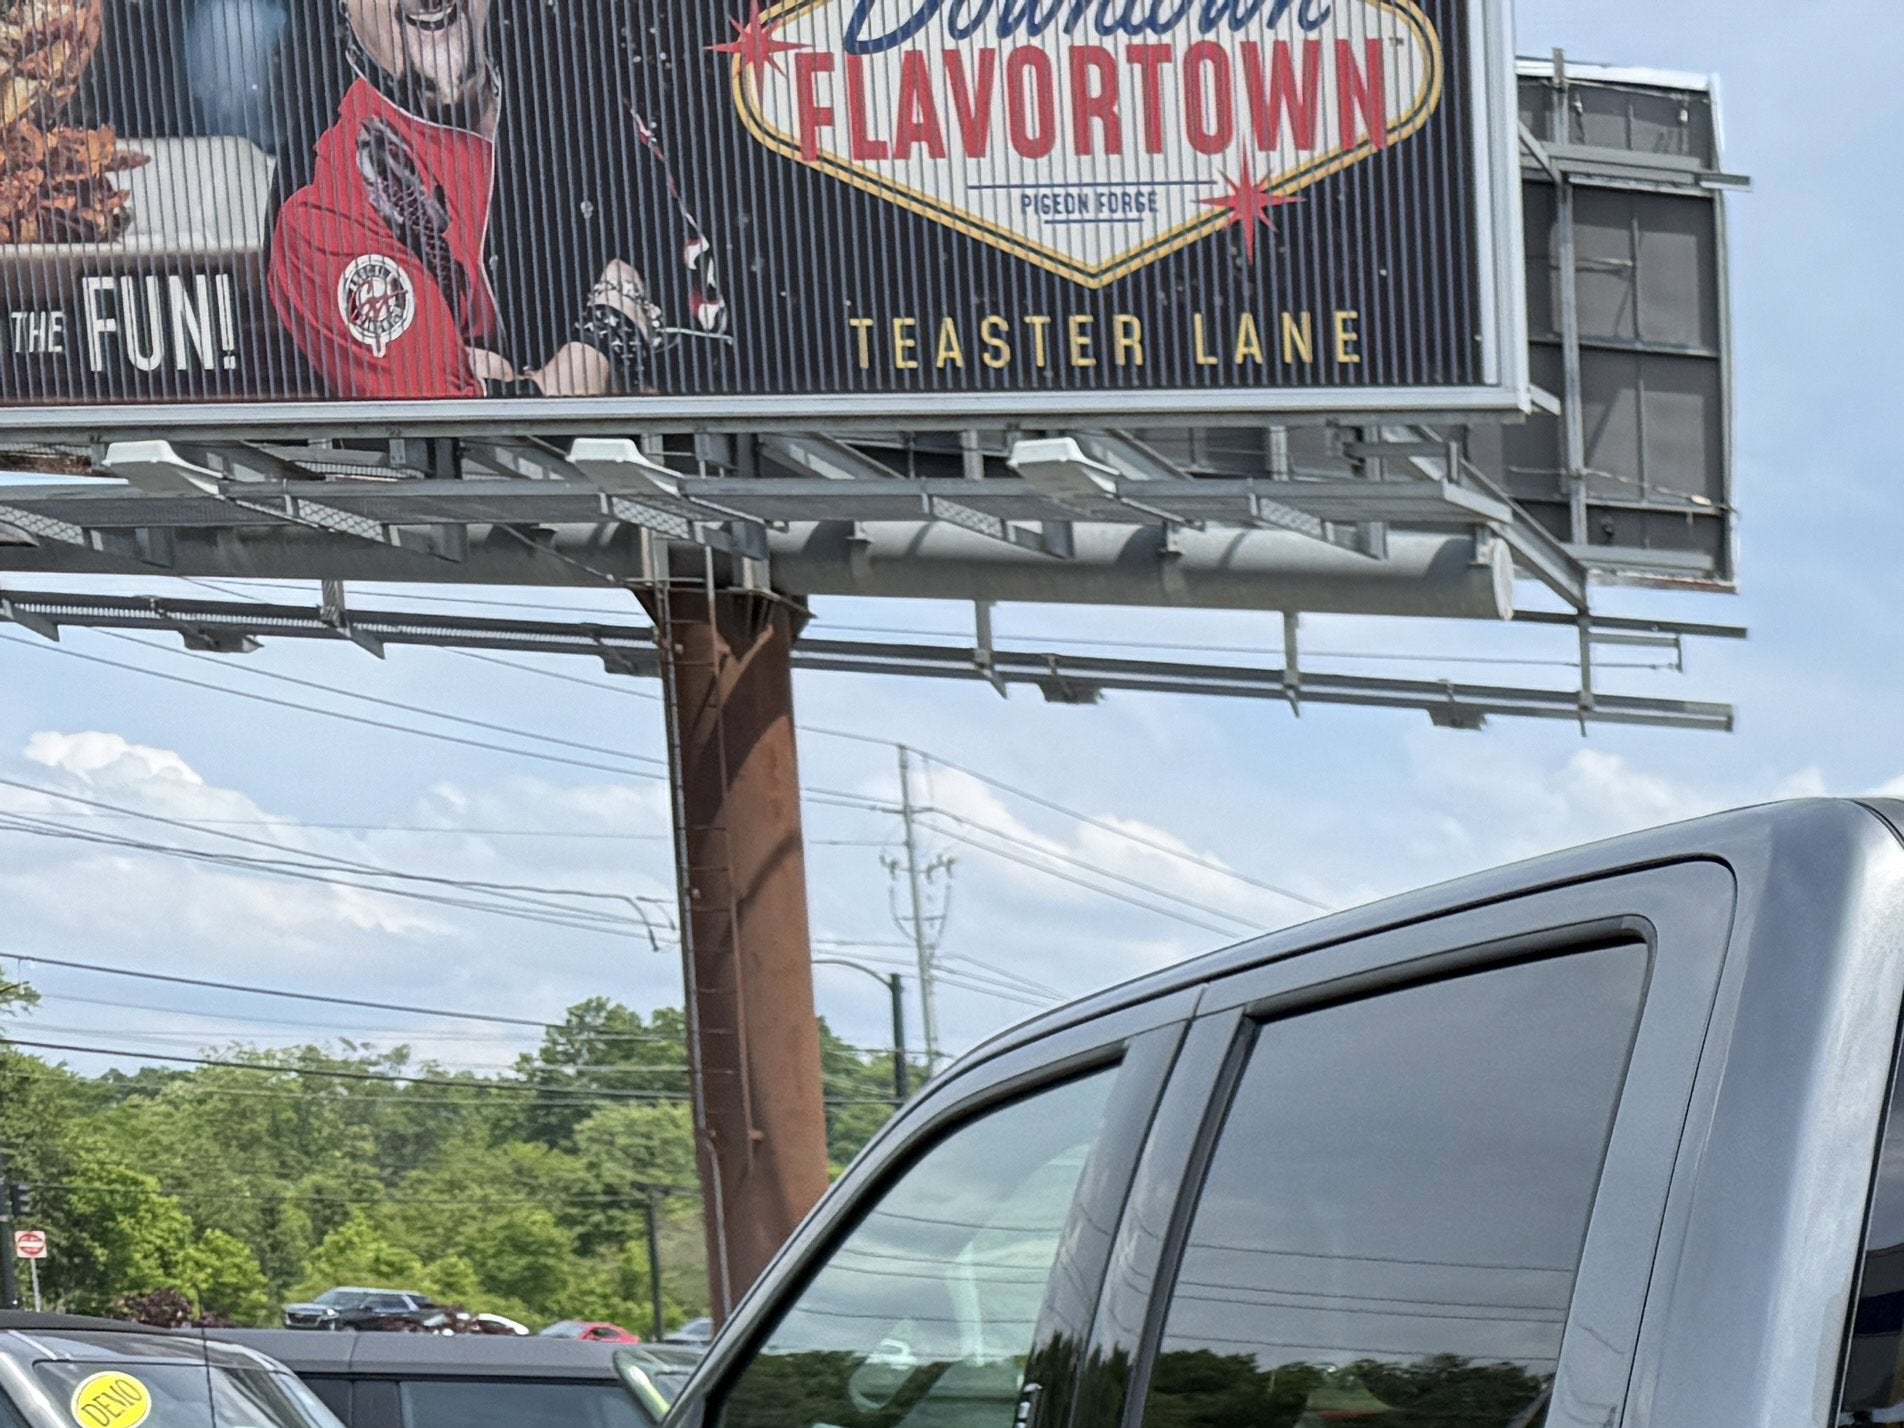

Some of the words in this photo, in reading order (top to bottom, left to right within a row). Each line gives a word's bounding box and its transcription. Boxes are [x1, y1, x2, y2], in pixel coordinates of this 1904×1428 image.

[799, 37, 1388, 161] FLAVORTOWN
[1021, 192, 1090, 214] PIGEON
[1096, 190, 1158, 213] FORGE
[11, 311, 65, 353] THE
[83, 273, 236, 371] FUN!
[849, 313, 1144, 369] TEASTER
[1193, 310, 1360, 365] LANE
[81, 1379, 142, 1427] DEMO
